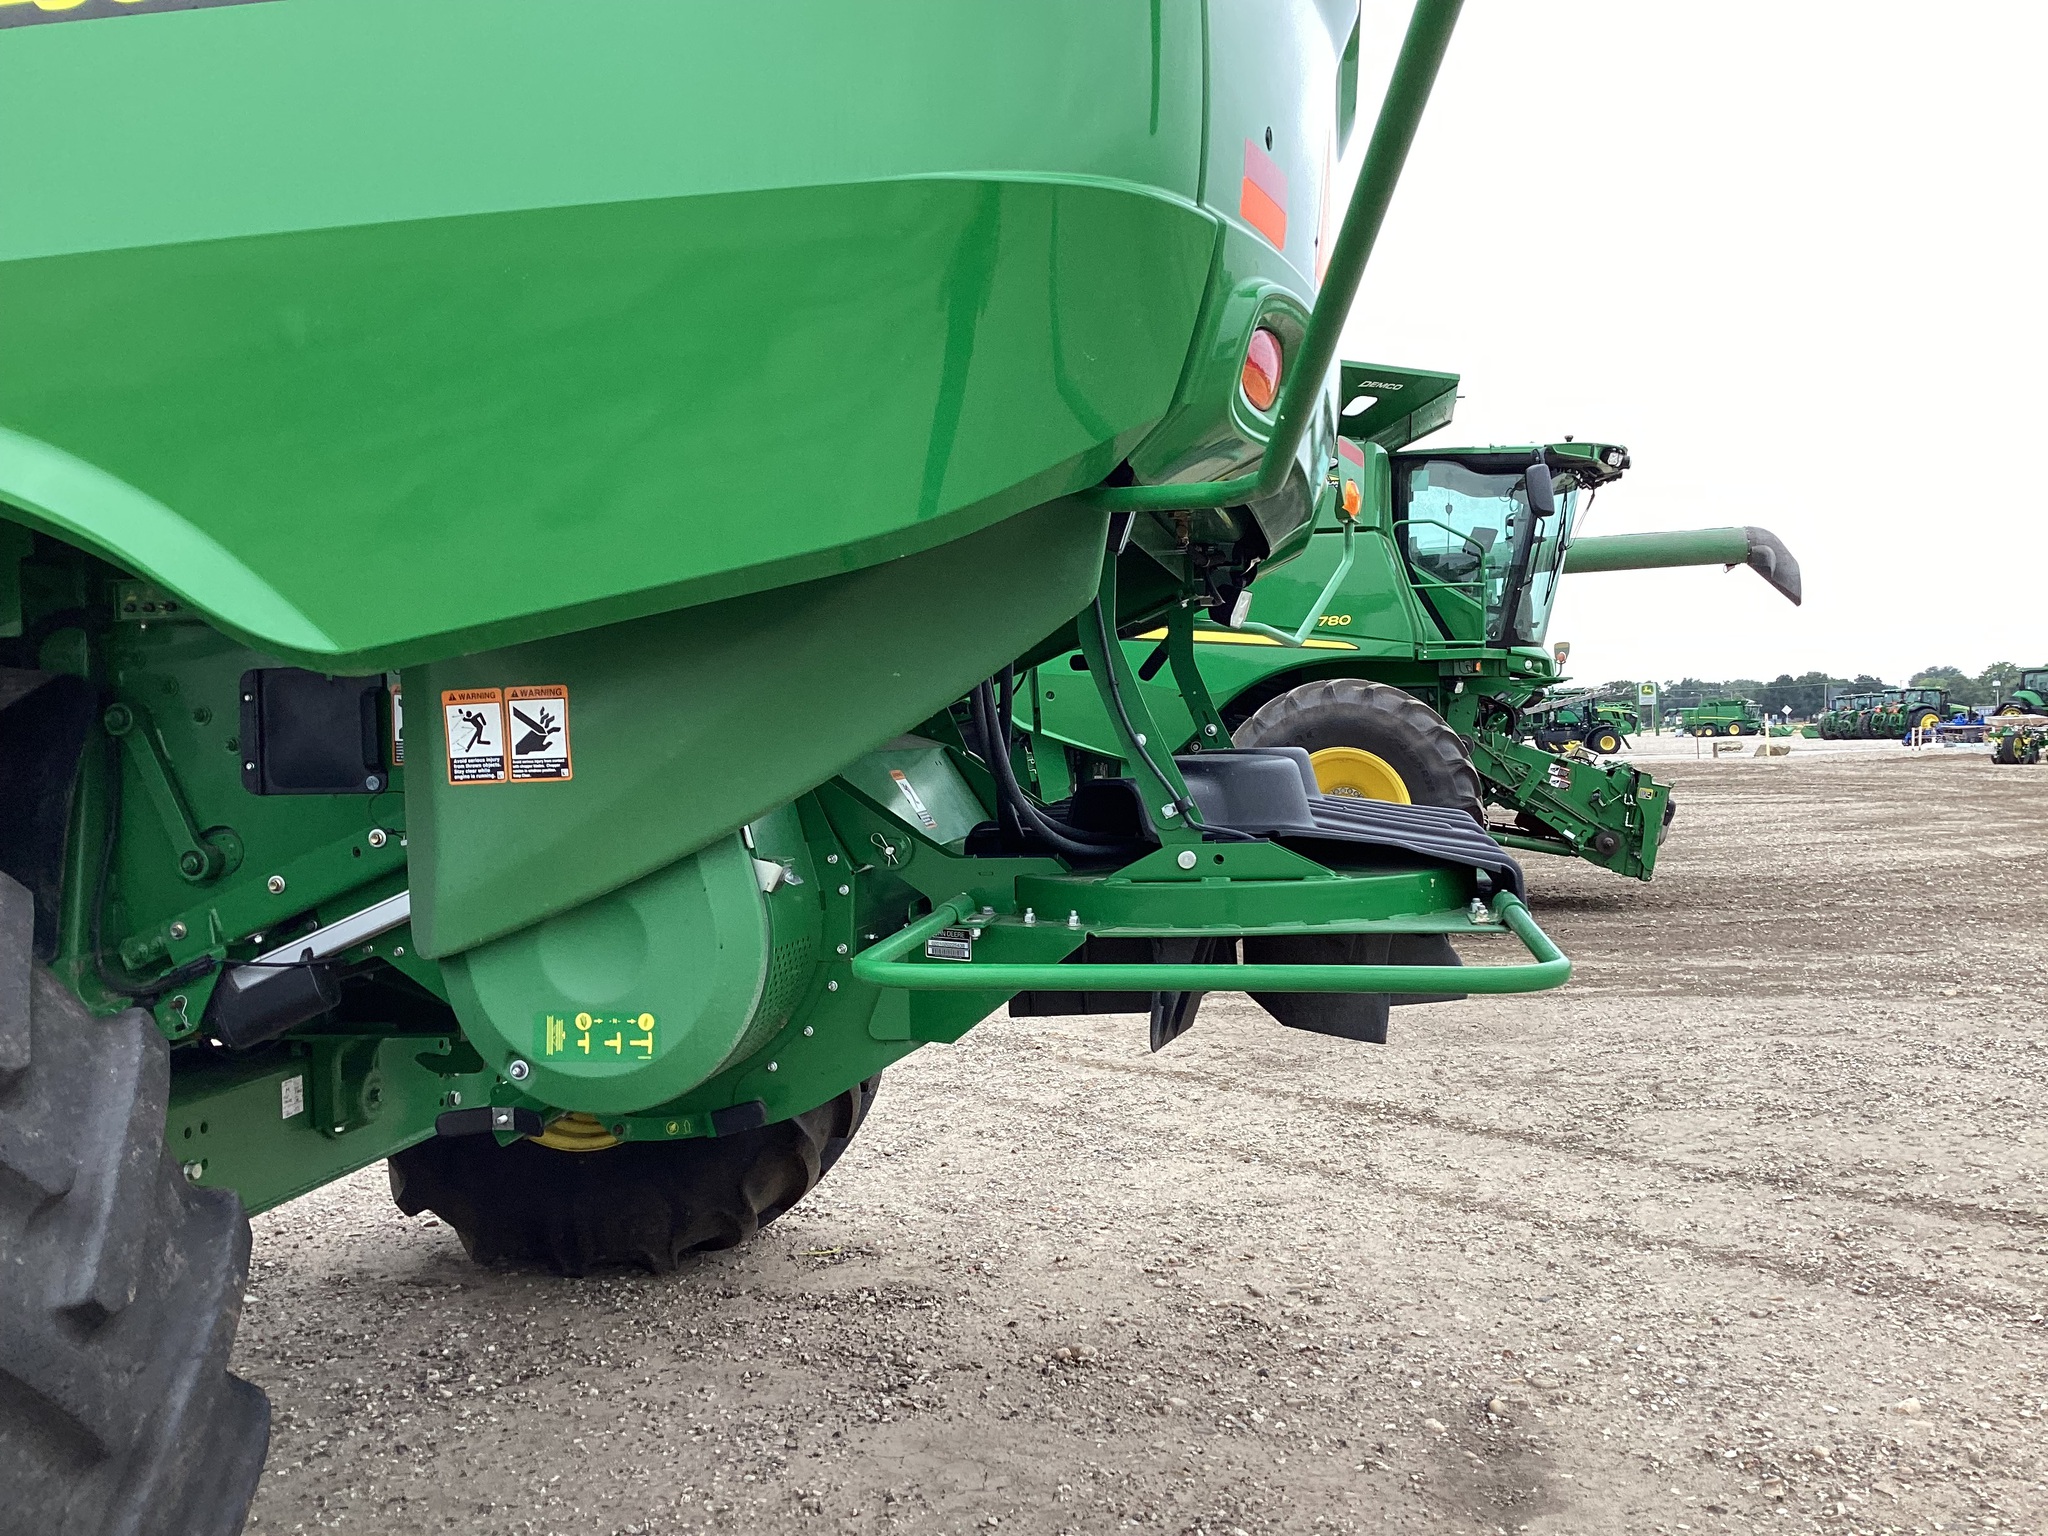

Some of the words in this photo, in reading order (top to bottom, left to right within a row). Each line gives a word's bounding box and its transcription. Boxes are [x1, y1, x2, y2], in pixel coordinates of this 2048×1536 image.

[1358, 381, 1404, 390] DEMCO
[458, 692, 496, 700] WARNING
[520, 688, 562, 697] WARNING
